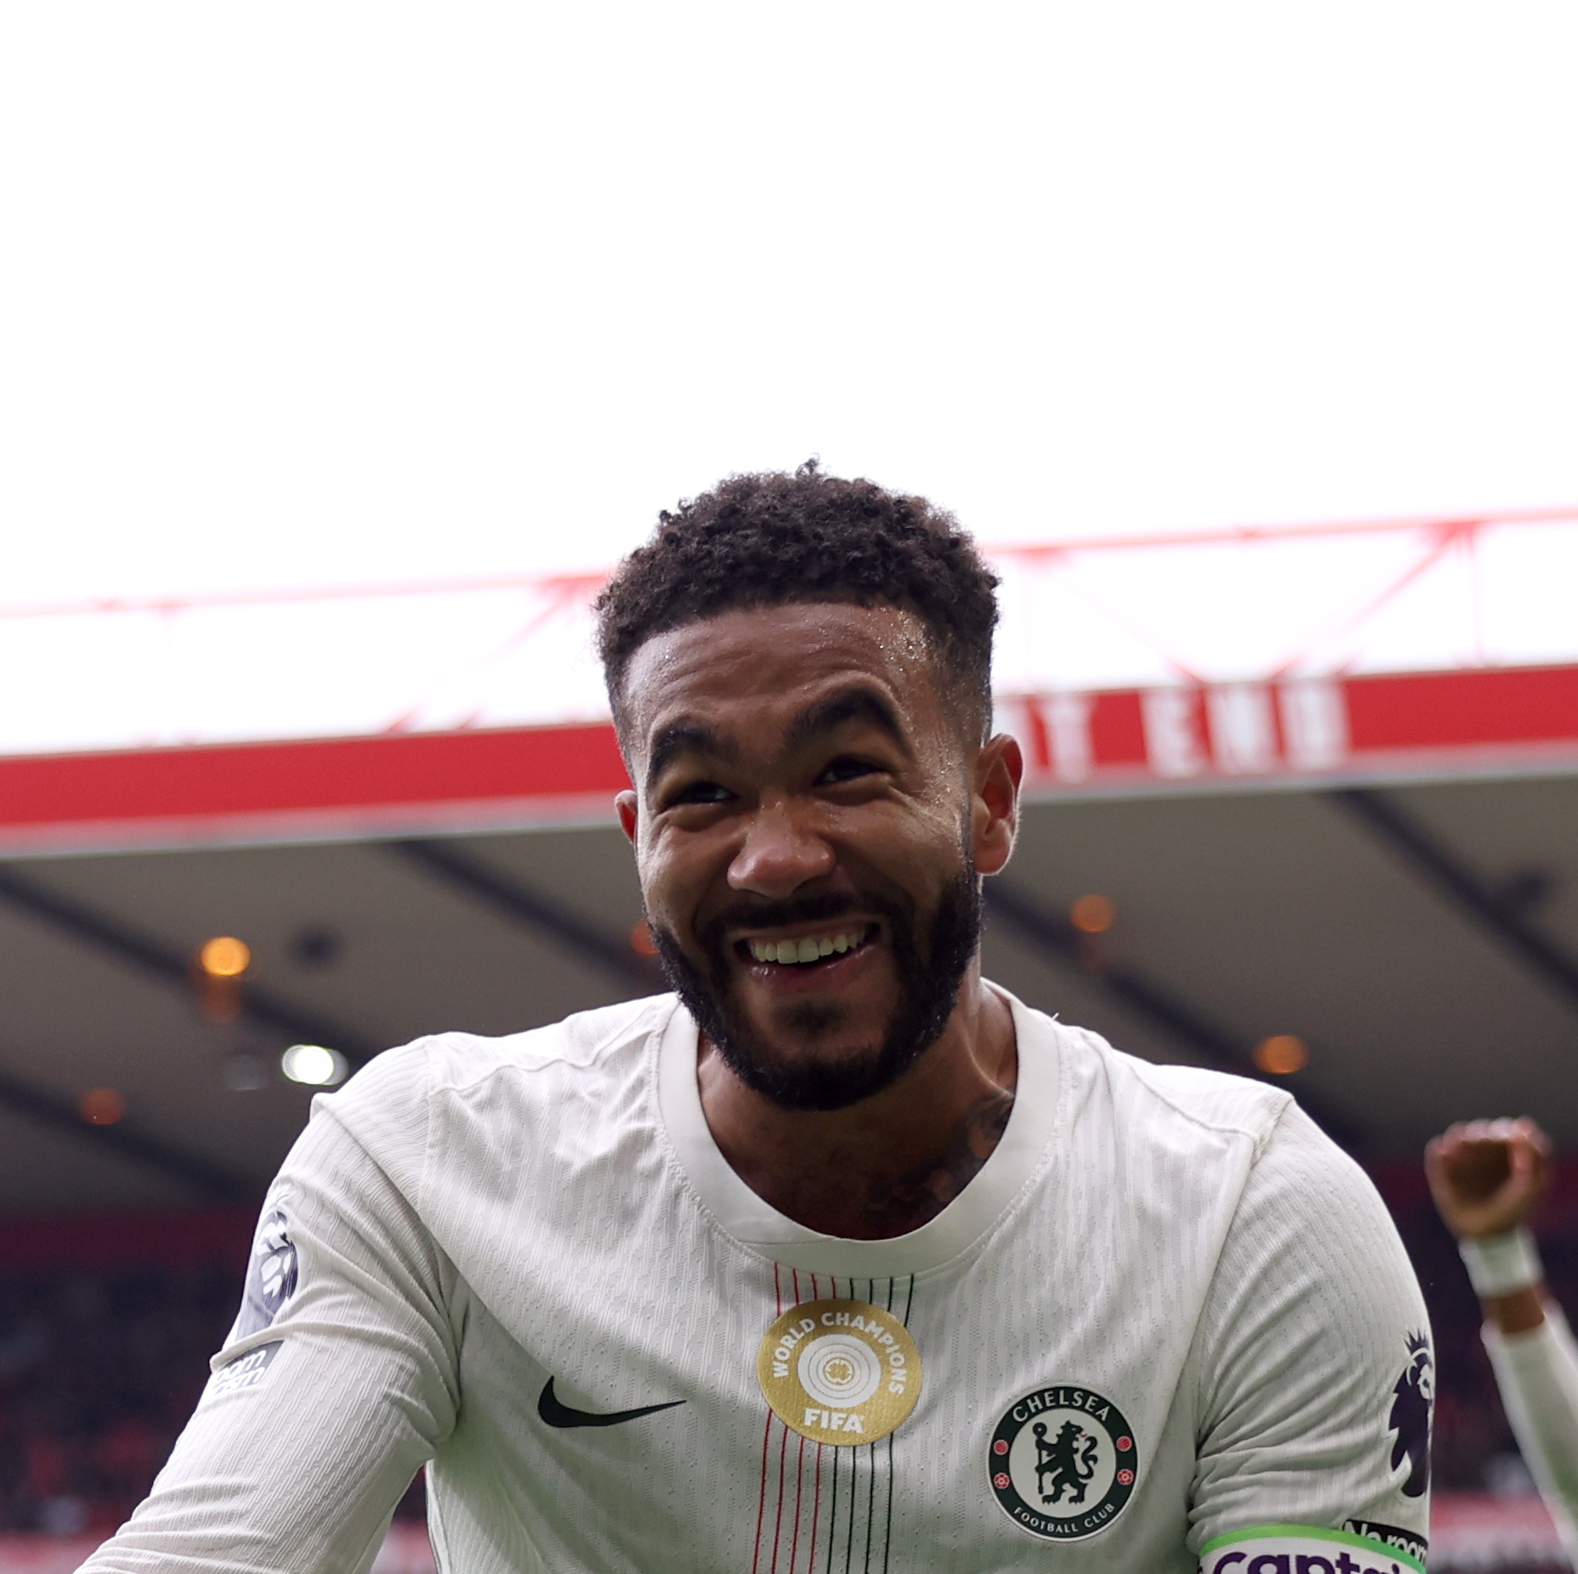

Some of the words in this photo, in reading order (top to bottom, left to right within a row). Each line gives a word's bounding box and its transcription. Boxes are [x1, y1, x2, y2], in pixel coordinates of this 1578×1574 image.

[773, 1317, 816, 1378] WORLD
[821, 1311, 907, 1395] CHAMPIONS
[804, 1408, 865, 1434] FIFA
[1012, 1389, 1110, 1422] CHELSEA
[1013, 1506, 1078, 1534] FOOTBALL
[1084, 1502, 1115, 1528] CLUB
